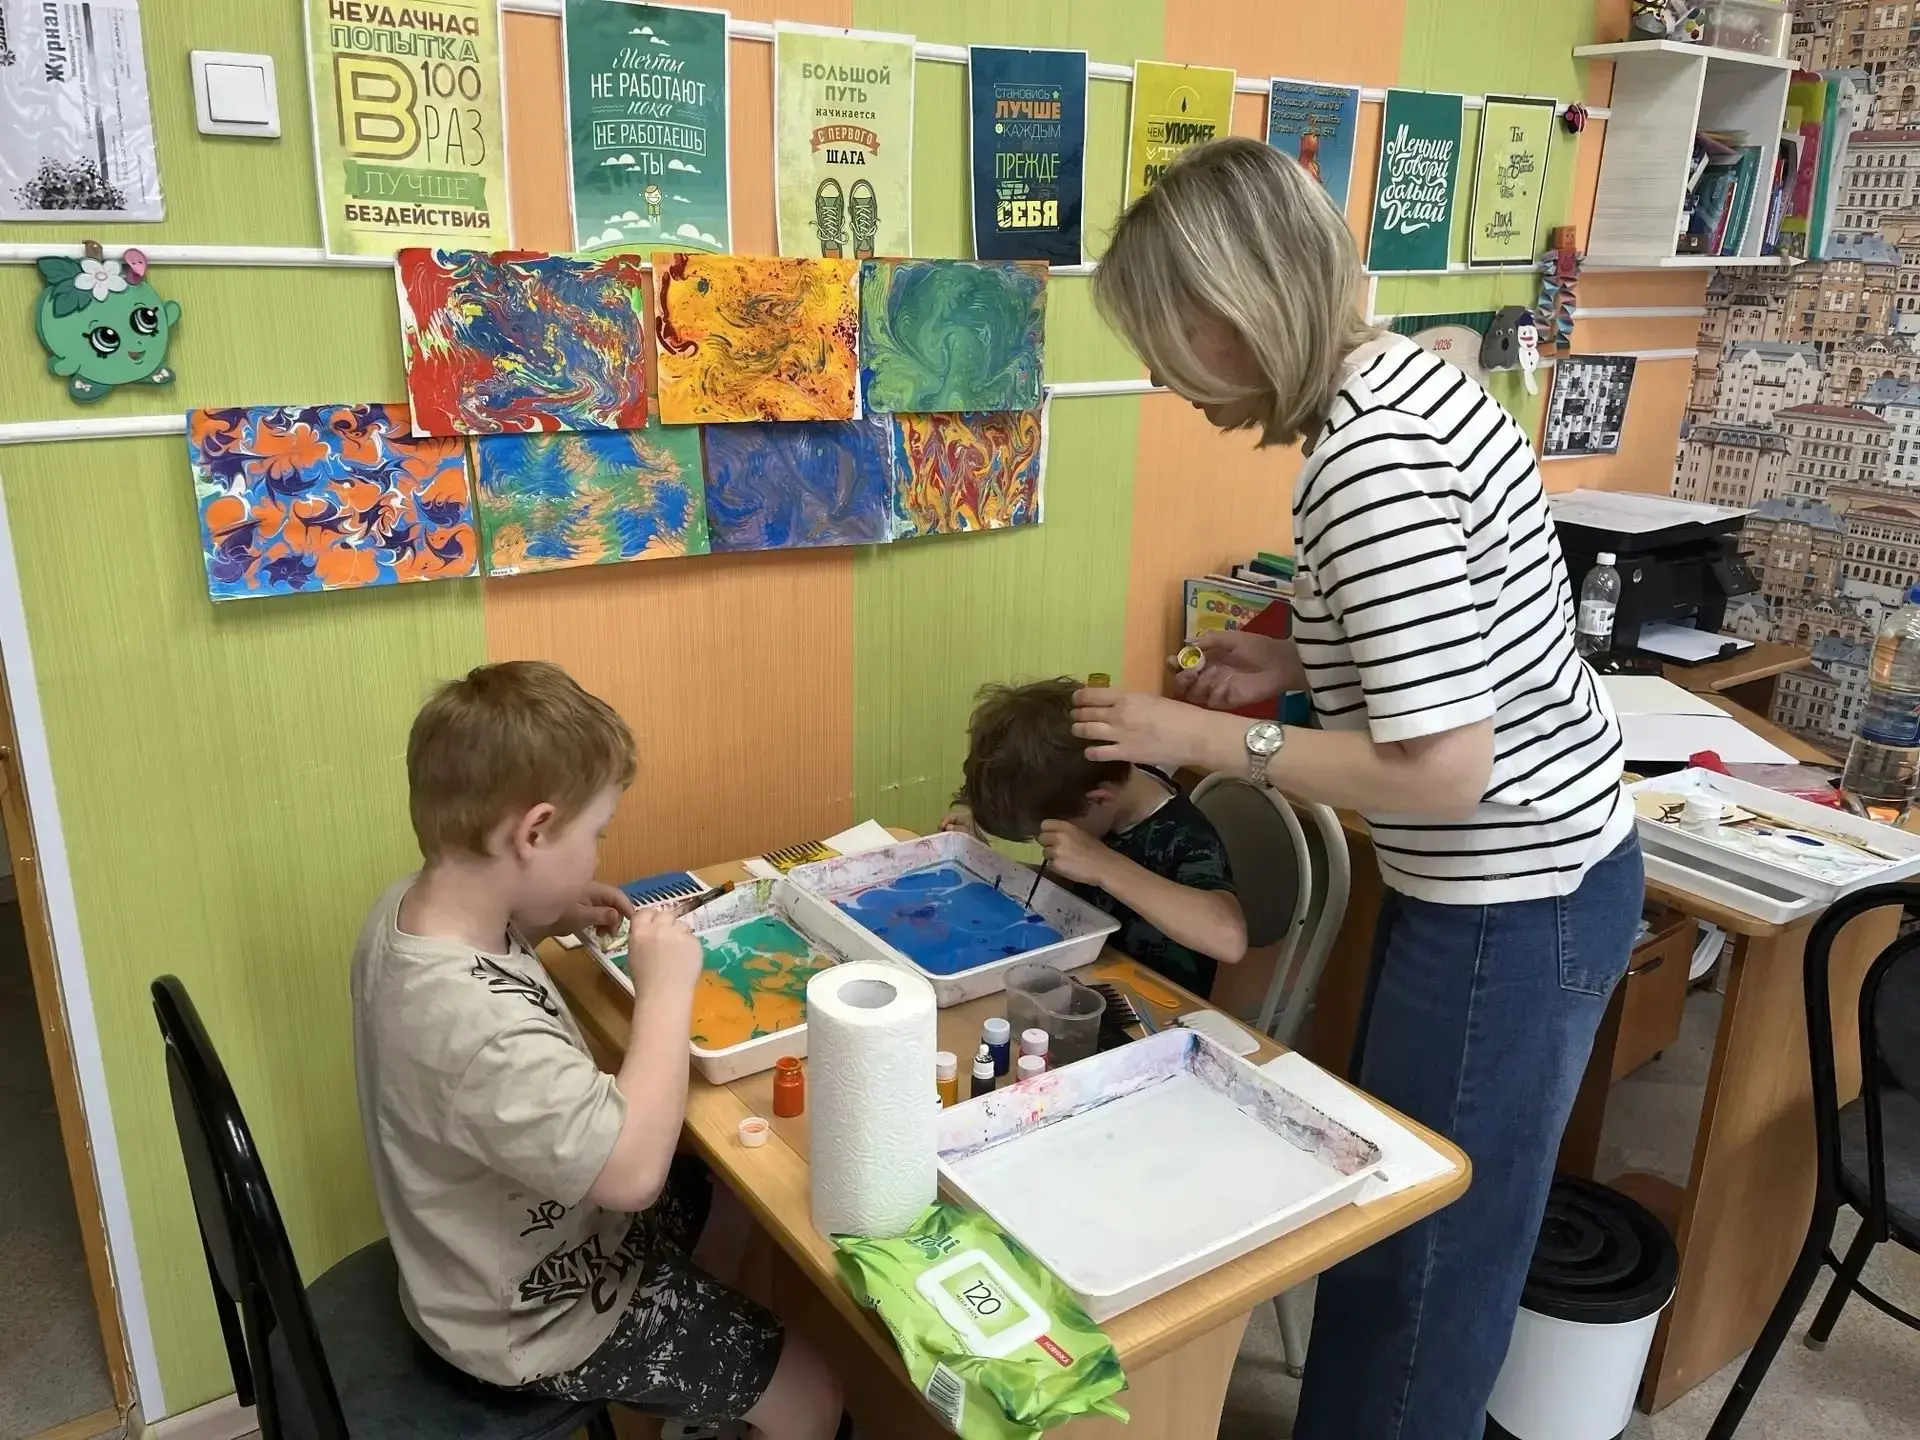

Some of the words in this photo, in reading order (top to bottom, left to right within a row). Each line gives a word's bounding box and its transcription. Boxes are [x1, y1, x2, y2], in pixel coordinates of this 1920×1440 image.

[330, 1, 479, 36] НЕУДАЧНАЯ
[43, 2, 66, 82] Журнал
[331, 24, 480, 63] ПОПЫТКА
[612, 47, 685, 74] Мечты
[802, 63, 890, 85] БОЛЬШОЙ
[591, 72, 613, 98] НЕ
[619, 73, 706, 106] РАБОТАЮТ
[825, 86, 868, 103] ПУТЬ
[333, 52, 422, 160] В
[421, 61, 482, 101] 100
[627, 101, 673, 118] пока
[816, 108, 876, 119] начинается
[995, 101, 1061, 119] ЛУЧШЕ
[425, 105, 486, 166] РАЗ
[596, 124, 615, 145] НЕ
[620, 124, 702, 151] РАБОТАЕШЬ
[828, 127, 873, 145] ПЕРВОГО
[1003, 124, 1060, 140] КАЖДЫМ
[1148, 127, 1164, 138] ЧЕМ
[640, 152, 664, 175] ТЫ
[826, 149, 866, 165] ШАГА
[996, 153, 1060, 183] ПРЕЖДЕ
[364, 171, 470, 200] ЛУЧШЕ
[345, 204, 490, 228] БЕЗДЕЙСТВИЯ
[997, 200, 1058, 228] СЕБЯ
[1433, 338, 1452, 351] 2026
[963, 1279, 1001, 1315] 120
[1043, 1341, 1070, 1365] НОВИНКА
